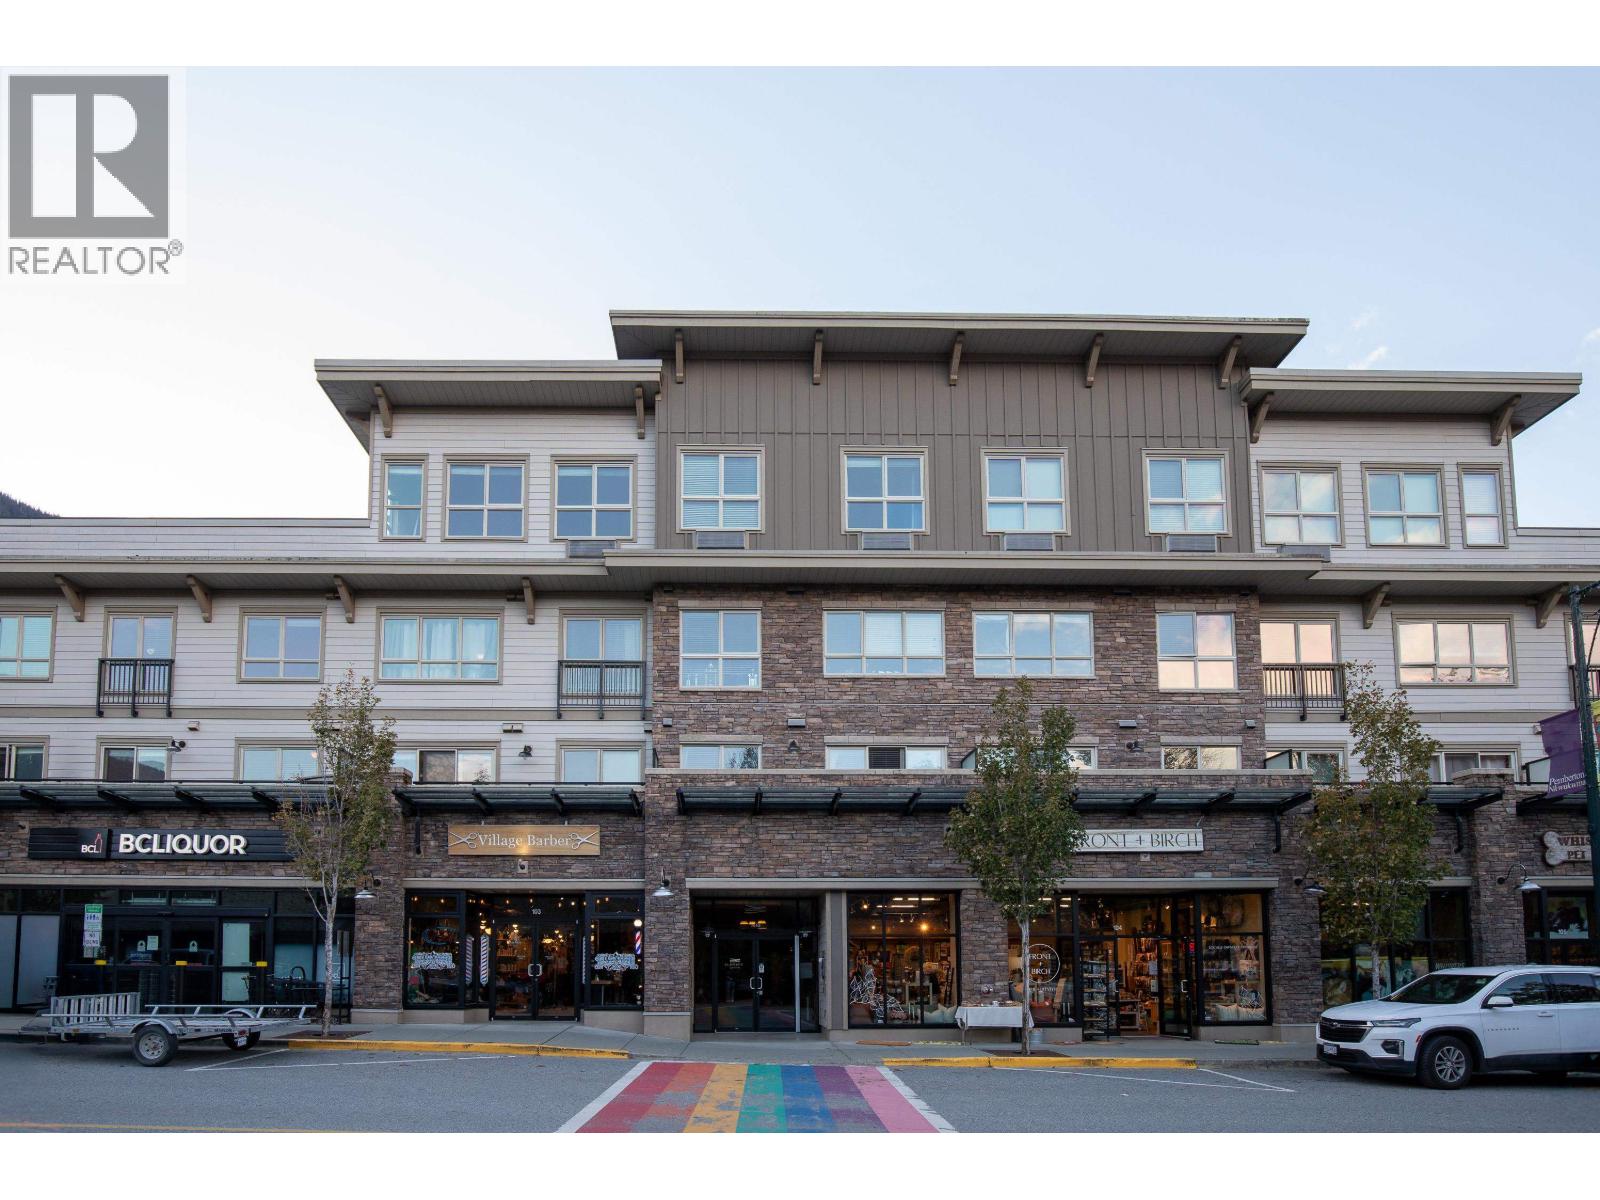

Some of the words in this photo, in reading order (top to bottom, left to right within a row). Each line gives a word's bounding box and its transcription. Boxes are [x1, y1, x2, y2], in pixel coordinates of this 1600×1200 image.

[1549, 772, 1586, 786] Pemberton
[118, 833, 248, 855] BCLIQUOR
[479, 834, 522, 849] Village
[527, 834, 571, 846] Barber
[1079, 832, 1127, 848] RONT
[1150, 832, 1198, 848] BIRCH
[81, 844, 99, 854] BCL
[1567, 849, 1586, 860] PET
